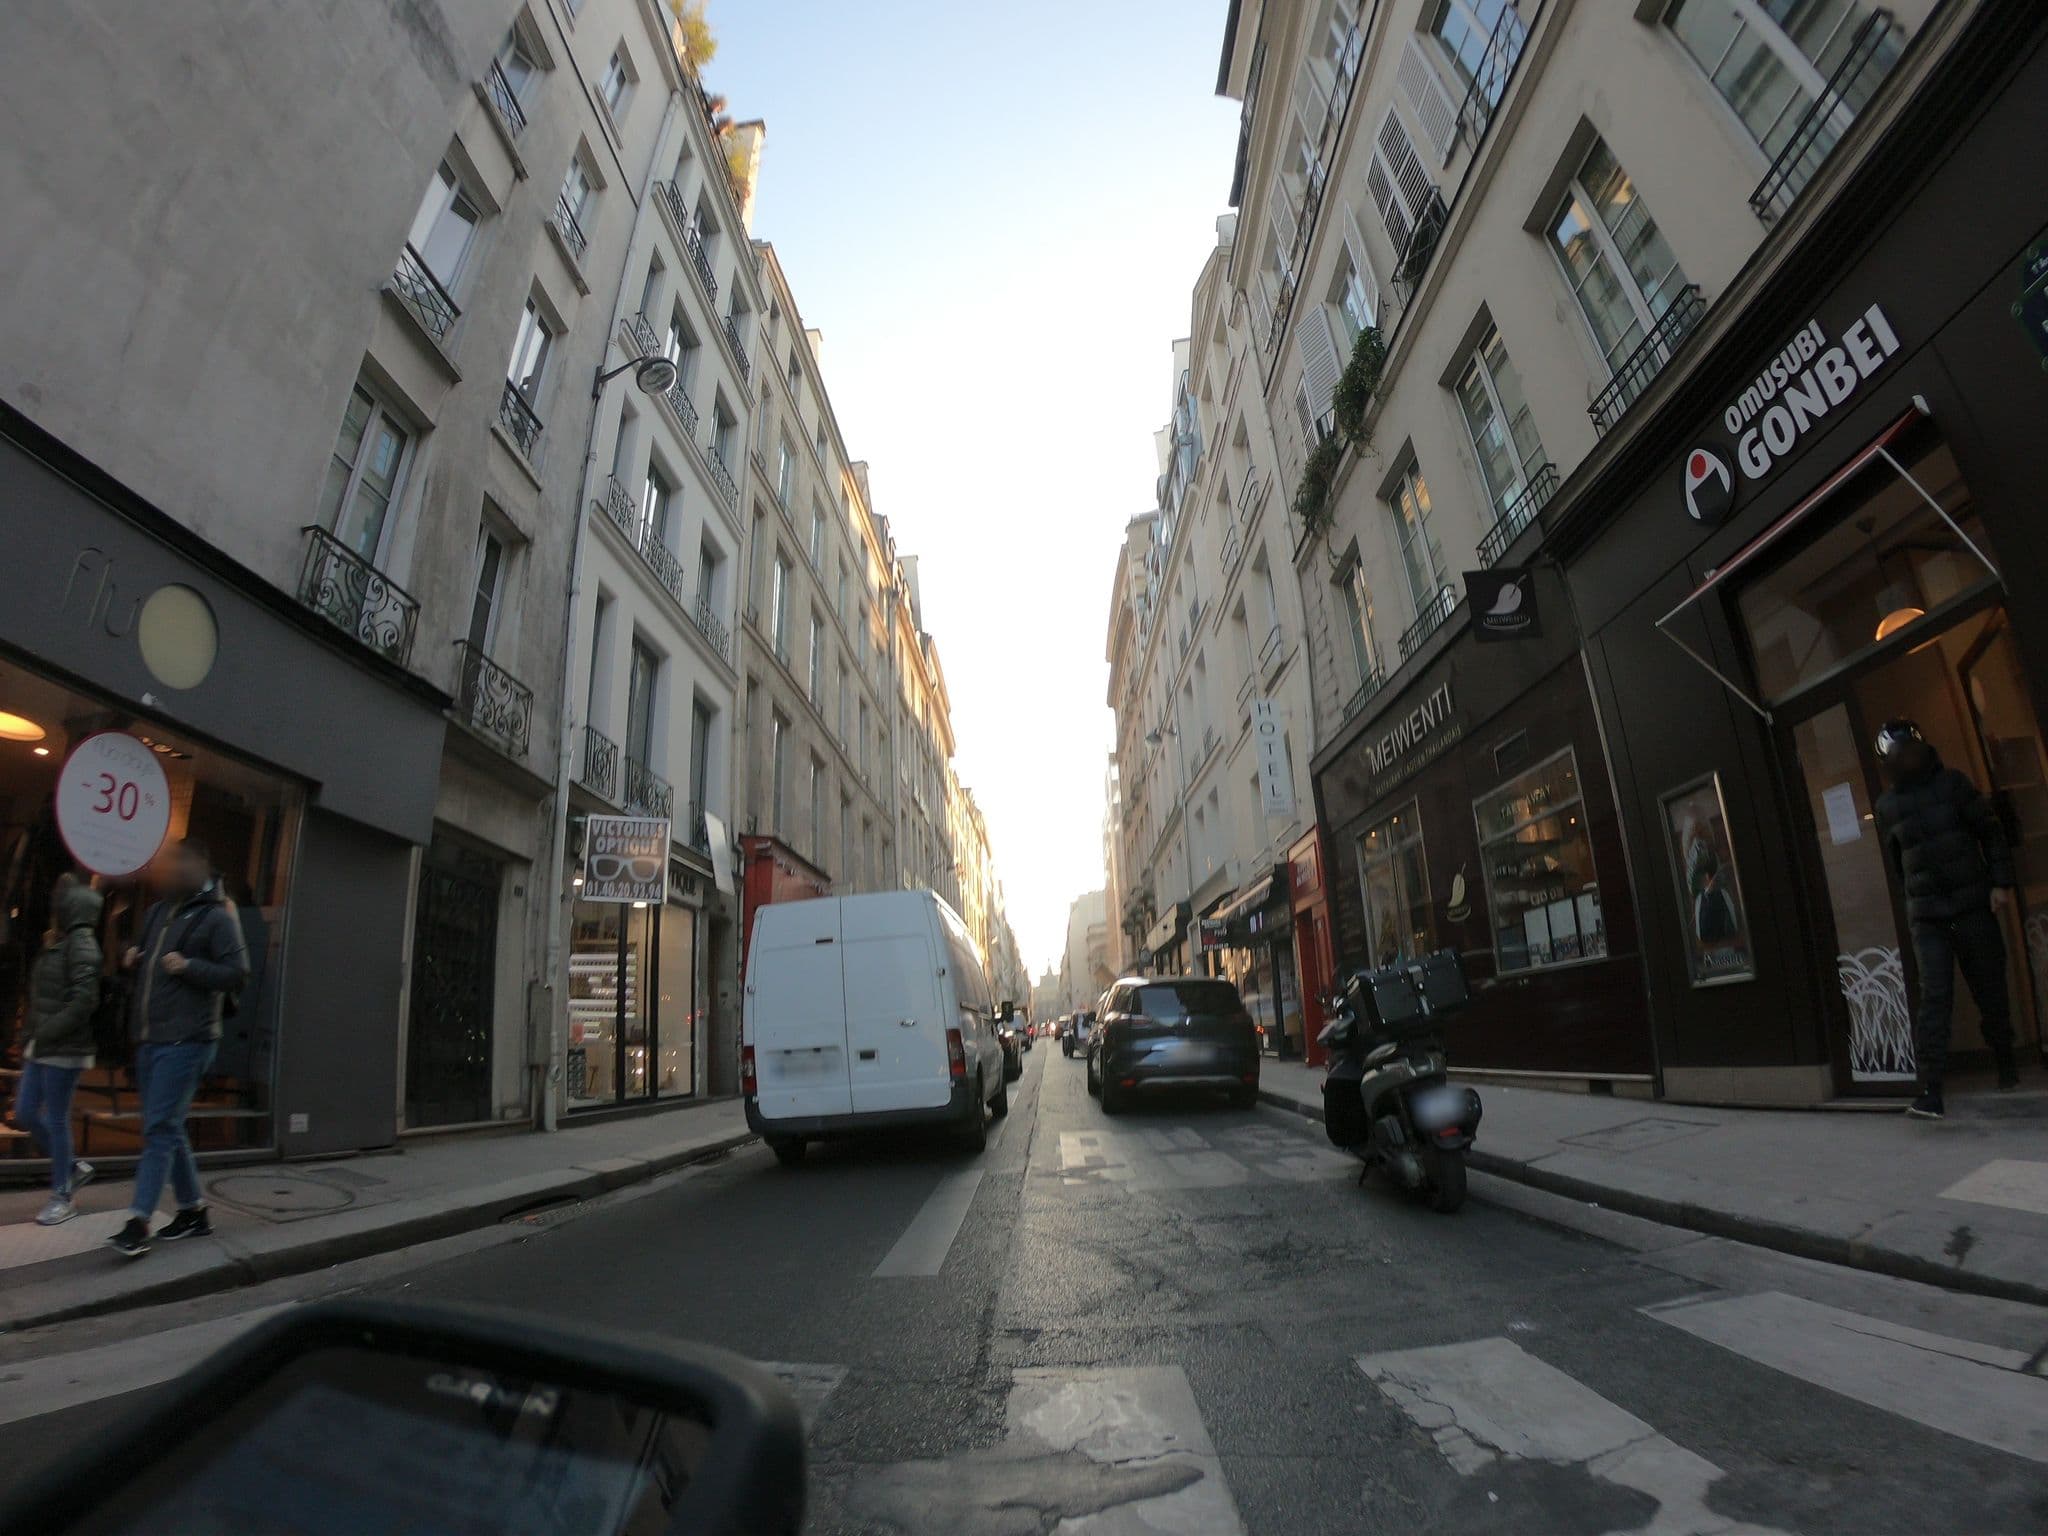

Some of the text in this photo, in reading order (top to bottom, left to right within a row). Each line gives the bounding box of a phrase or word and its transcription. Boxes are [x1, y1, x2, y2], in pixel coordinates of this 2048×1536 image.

[1738, 303, 1900, 480] GONBEI
[1370, 682, 1451, 776] MEIWENTI
[591, 820, 665, 838] VICTOIRES
[595, 836, 659, 856] OPTIQUE
